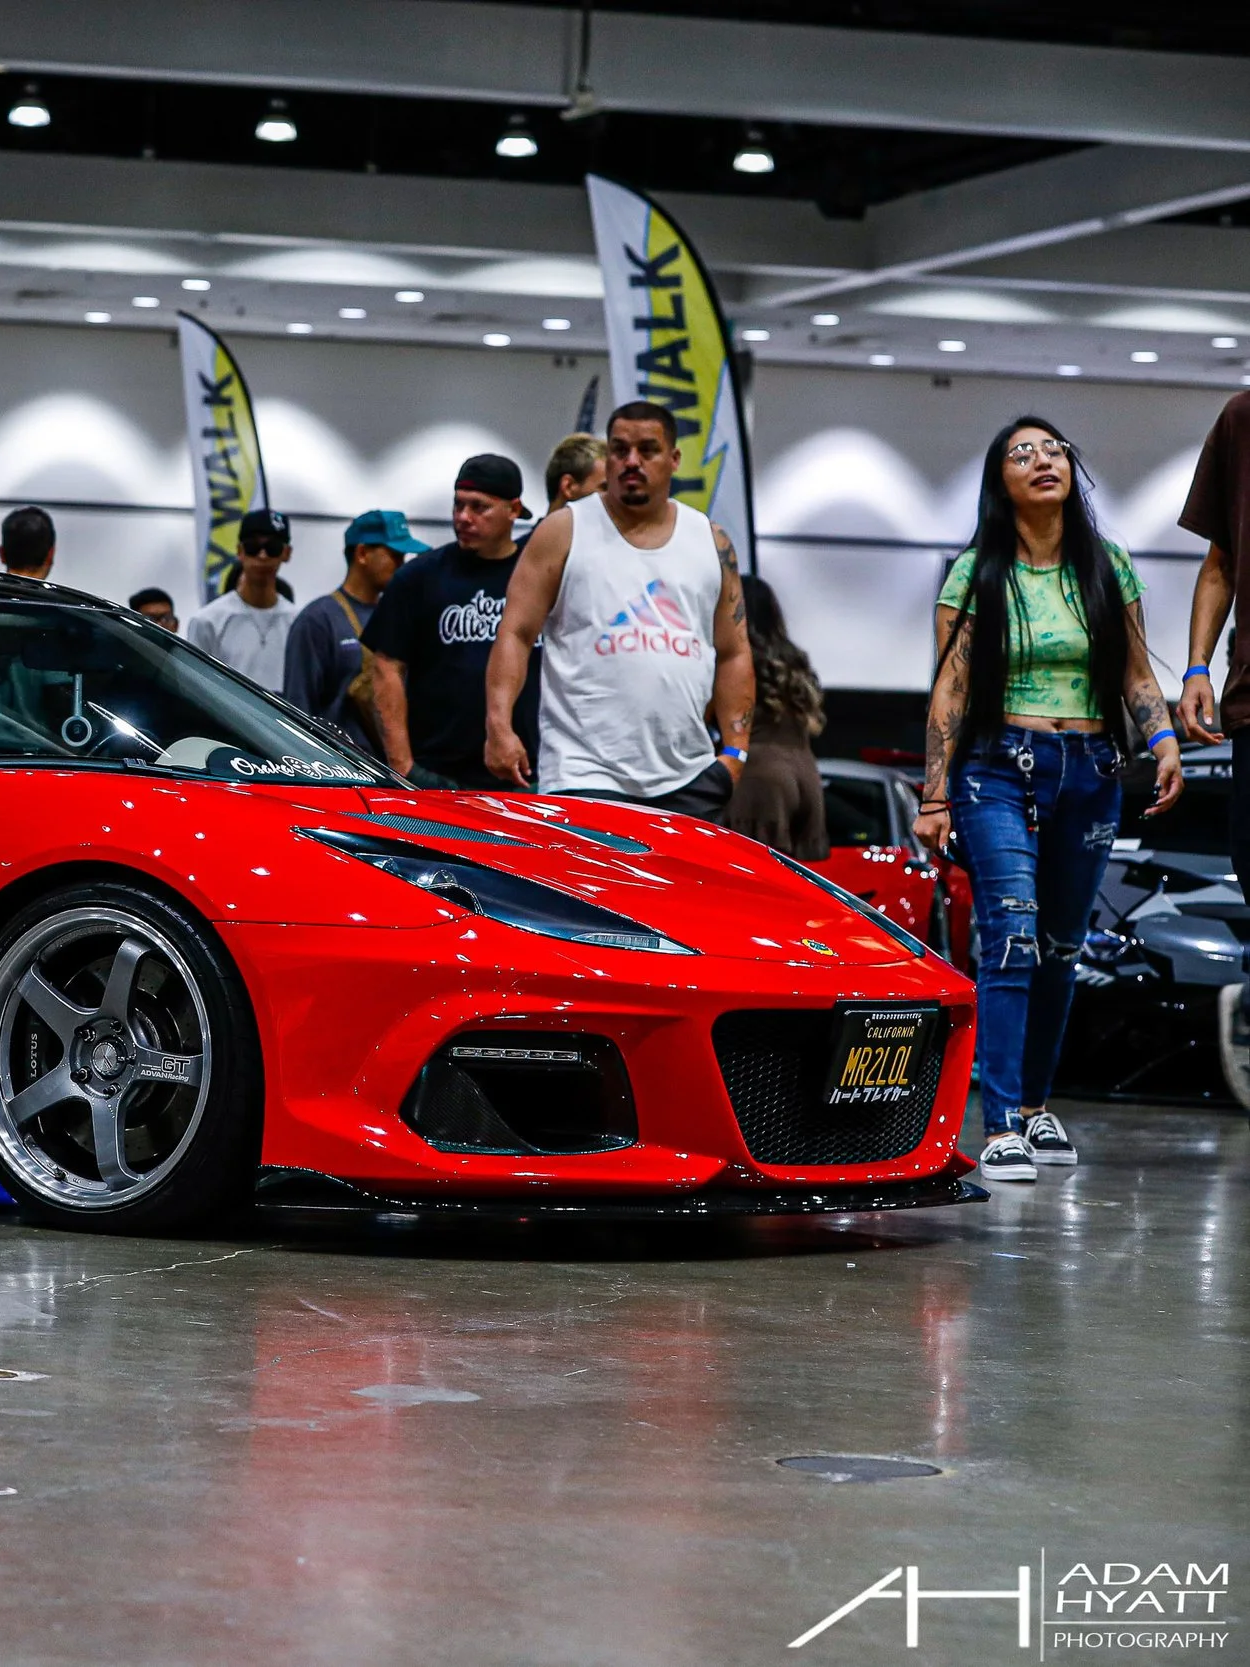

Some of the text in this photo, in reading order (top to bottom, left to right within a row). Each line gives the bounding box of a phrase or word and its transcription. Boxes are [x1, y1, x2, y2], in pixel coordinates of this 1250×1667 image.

[594, 628, 702, 660] adidas
[867, 1026, 915, 1039] CALIFORNIA
[30, 1033, 38, 1078] LOTUS
[161, 1056, 191, 1075] GT
